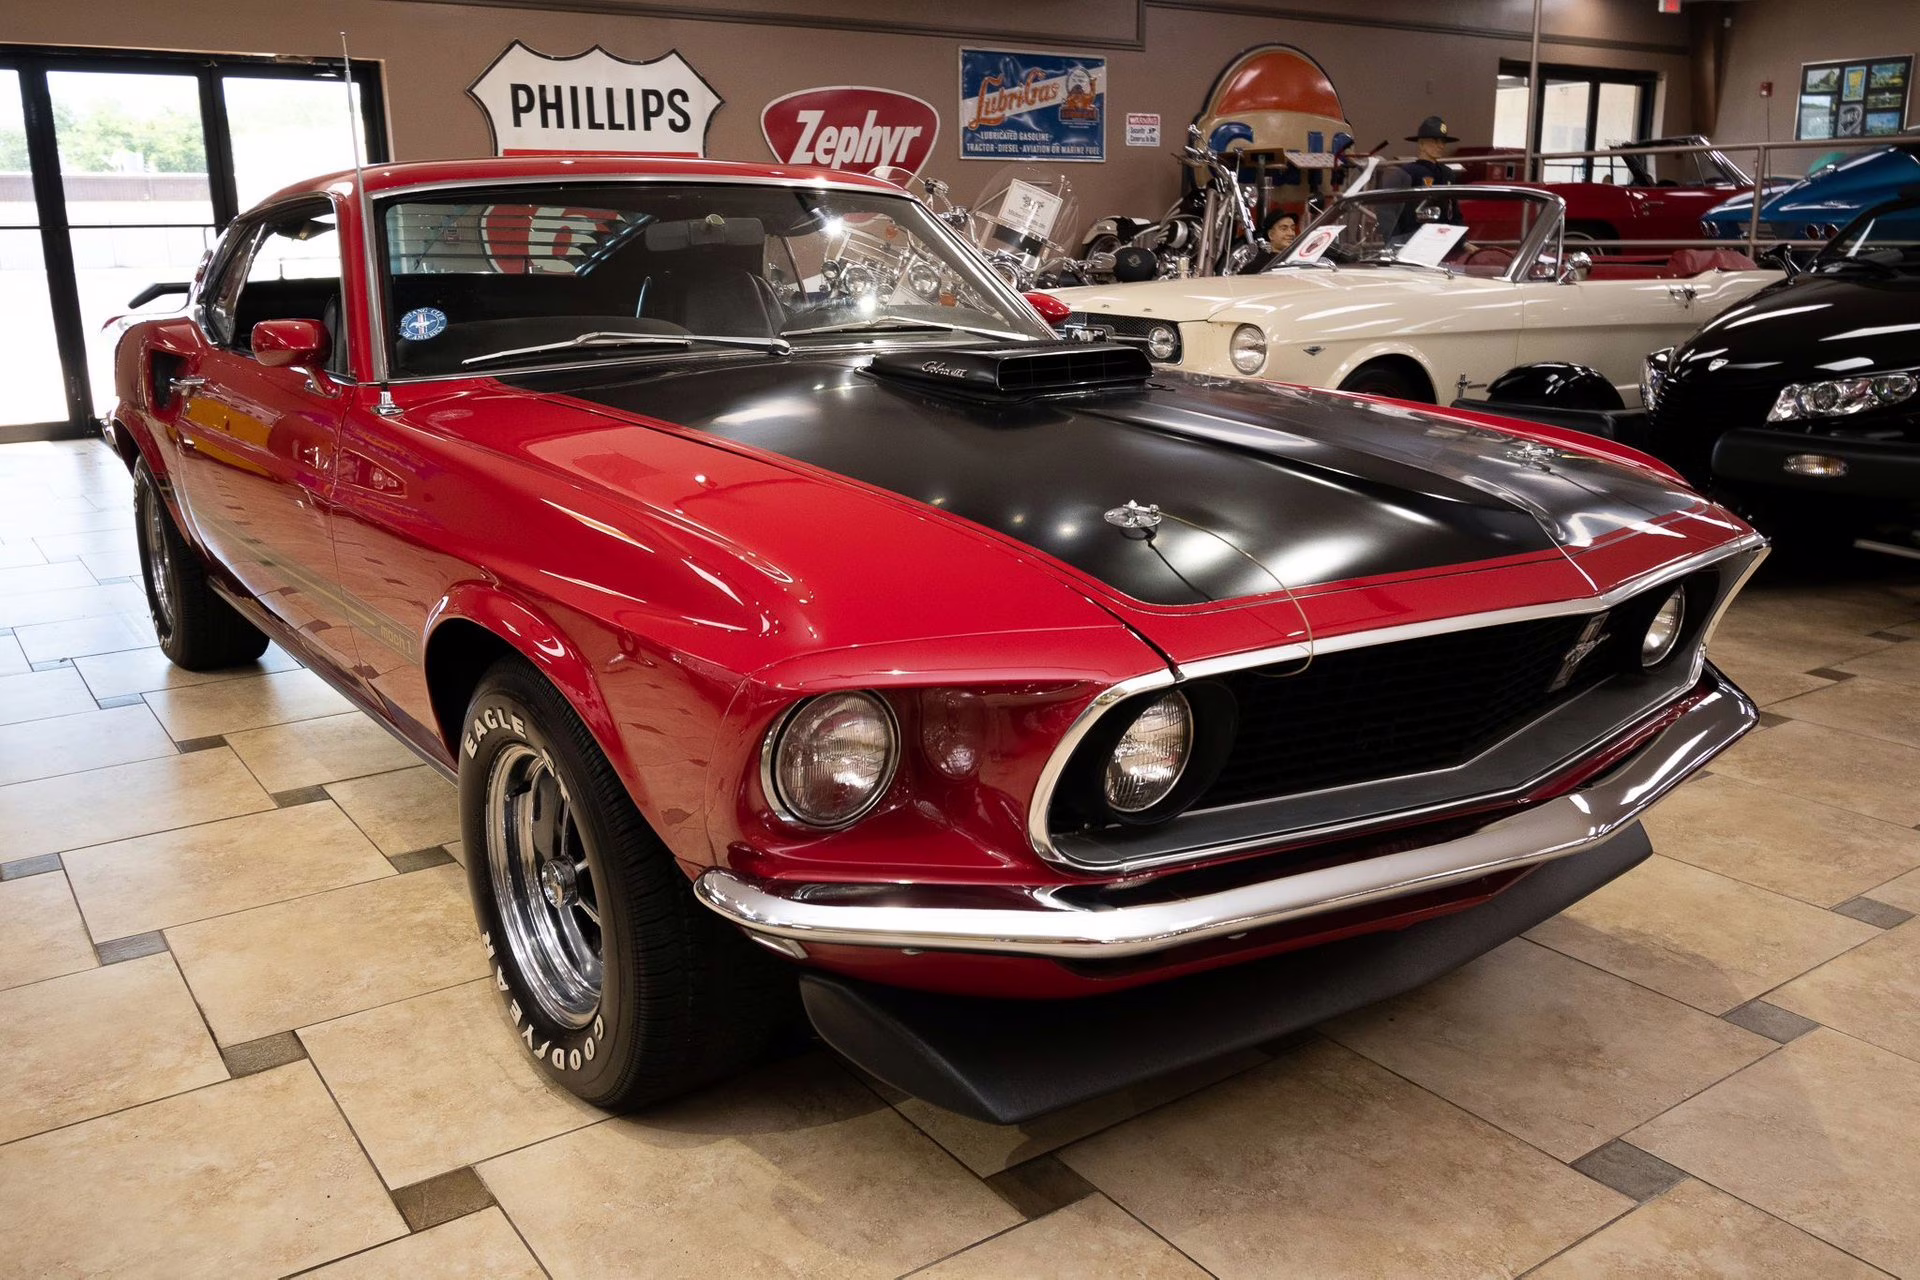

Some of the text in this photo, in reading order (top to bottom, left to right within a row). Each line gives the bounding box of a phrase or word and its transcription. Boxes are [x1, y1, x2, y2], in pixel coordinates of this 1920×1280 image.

[510, 82, 691, 133] PHILLIPS
[789, 109, 923, 179] Zephyr
[966, 143, 1100, 156] TRACTOR DIESEL AVIATION OR MARINE FUEL
[980, 131, 1049, 142] LUBRICATED GASOLINE
[432, 309, 448, 321] CLUB
[414, 326, 446, 341] AMERICA
[464, 706, 528, 760] EAGLE
[481, 929, 606, 1072] GOODYEAR
